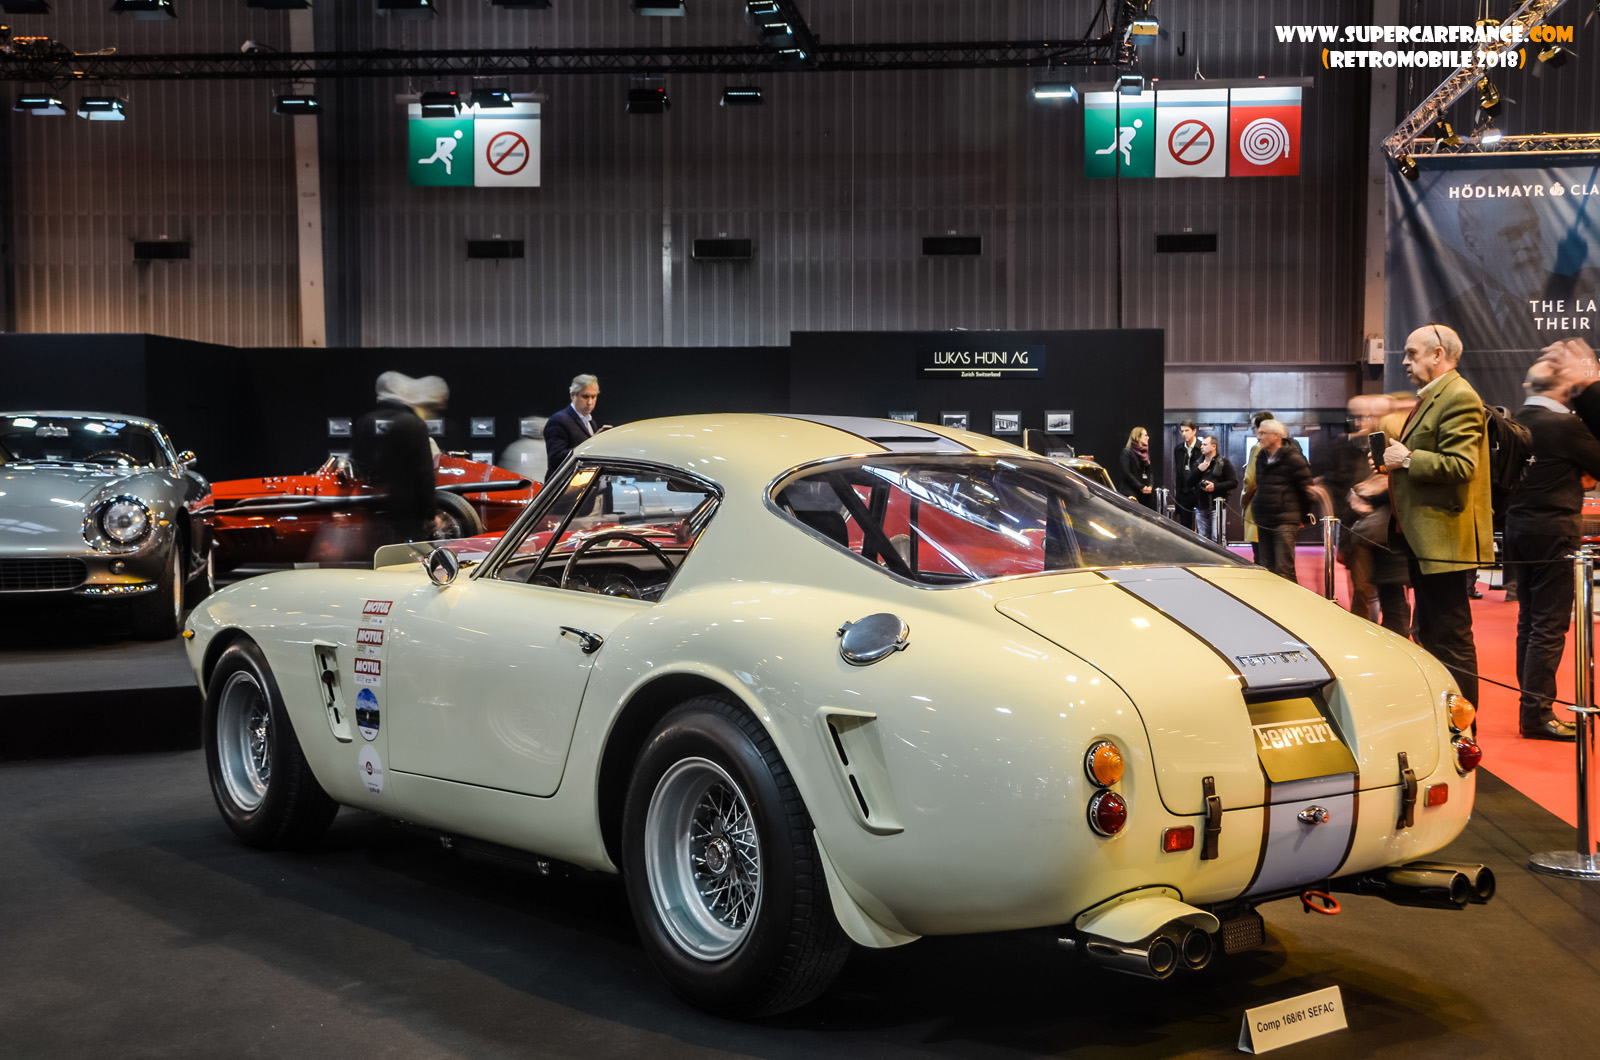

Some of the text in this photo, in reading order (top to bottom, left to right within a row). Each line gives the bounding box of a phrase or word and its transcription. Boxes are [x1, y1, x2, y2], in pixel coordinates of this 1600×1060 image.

[1449, 183, 1545, 199] HÖDLMAYR
[1529, 300, 1597, 313] THE LA
[1534, 317, 1591, 330] THEIR
[934, 351, 1028, 365] LUKAS HÜNI AG
[363, 601, 391, 614] MOTUL
[357, 629, 383, 643] MOTUL
[1235, 651, 1309, 668] Ferrari
[355, 660, 380, 674] MOTUL
[1252, 717, 1338, 750] Ferrari
[1257, 1001, 1335, 1033] Comp 168/61 SEFAC
